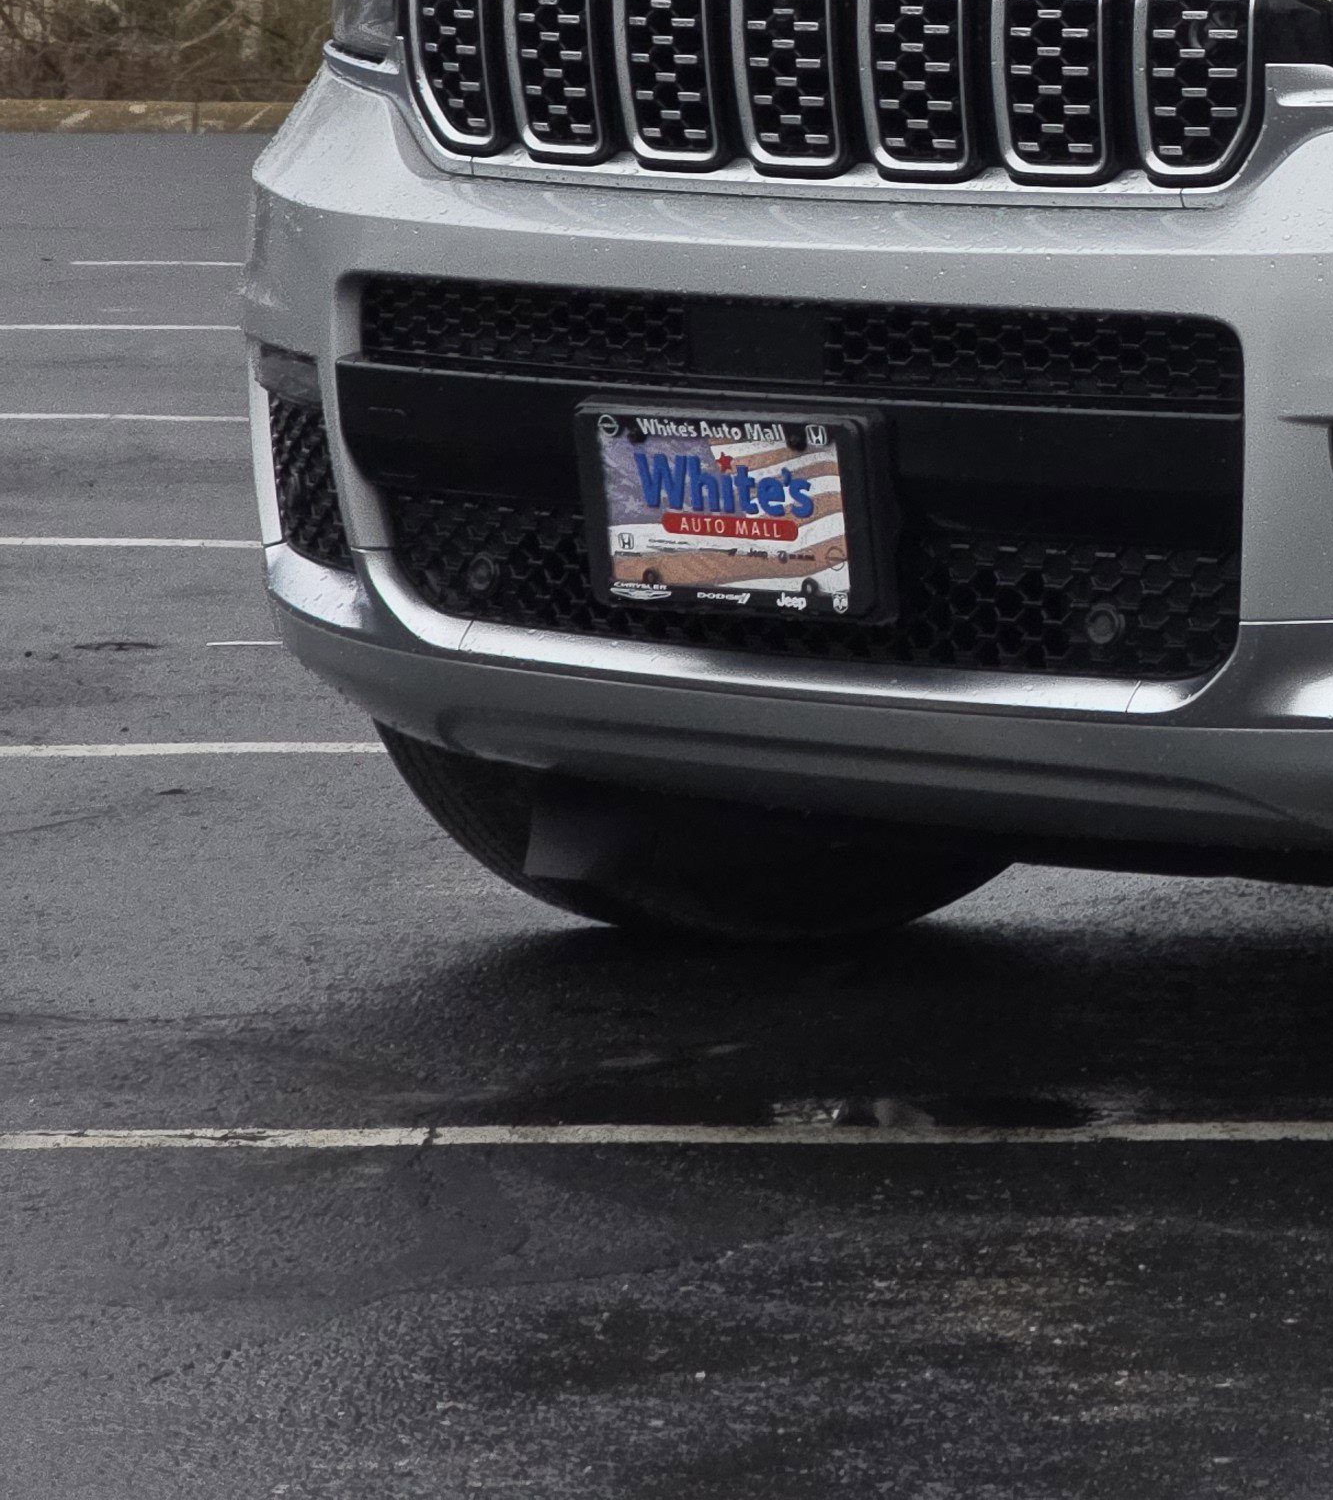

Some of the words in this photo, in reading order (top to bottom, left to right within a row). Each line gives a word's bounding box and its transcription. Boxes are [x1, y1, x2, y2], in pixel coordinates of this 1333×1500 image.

[635, 417, 698, 439] White's
[700, 421, 742, 441] Auto
[743, 422, 786, 443] Mall
[633, 451, 815, 519] White's
[679, 516, 725, 534] AUTO
[735, 520, 782, 538] MALL
[776, 591, 807, 611] Jeep
